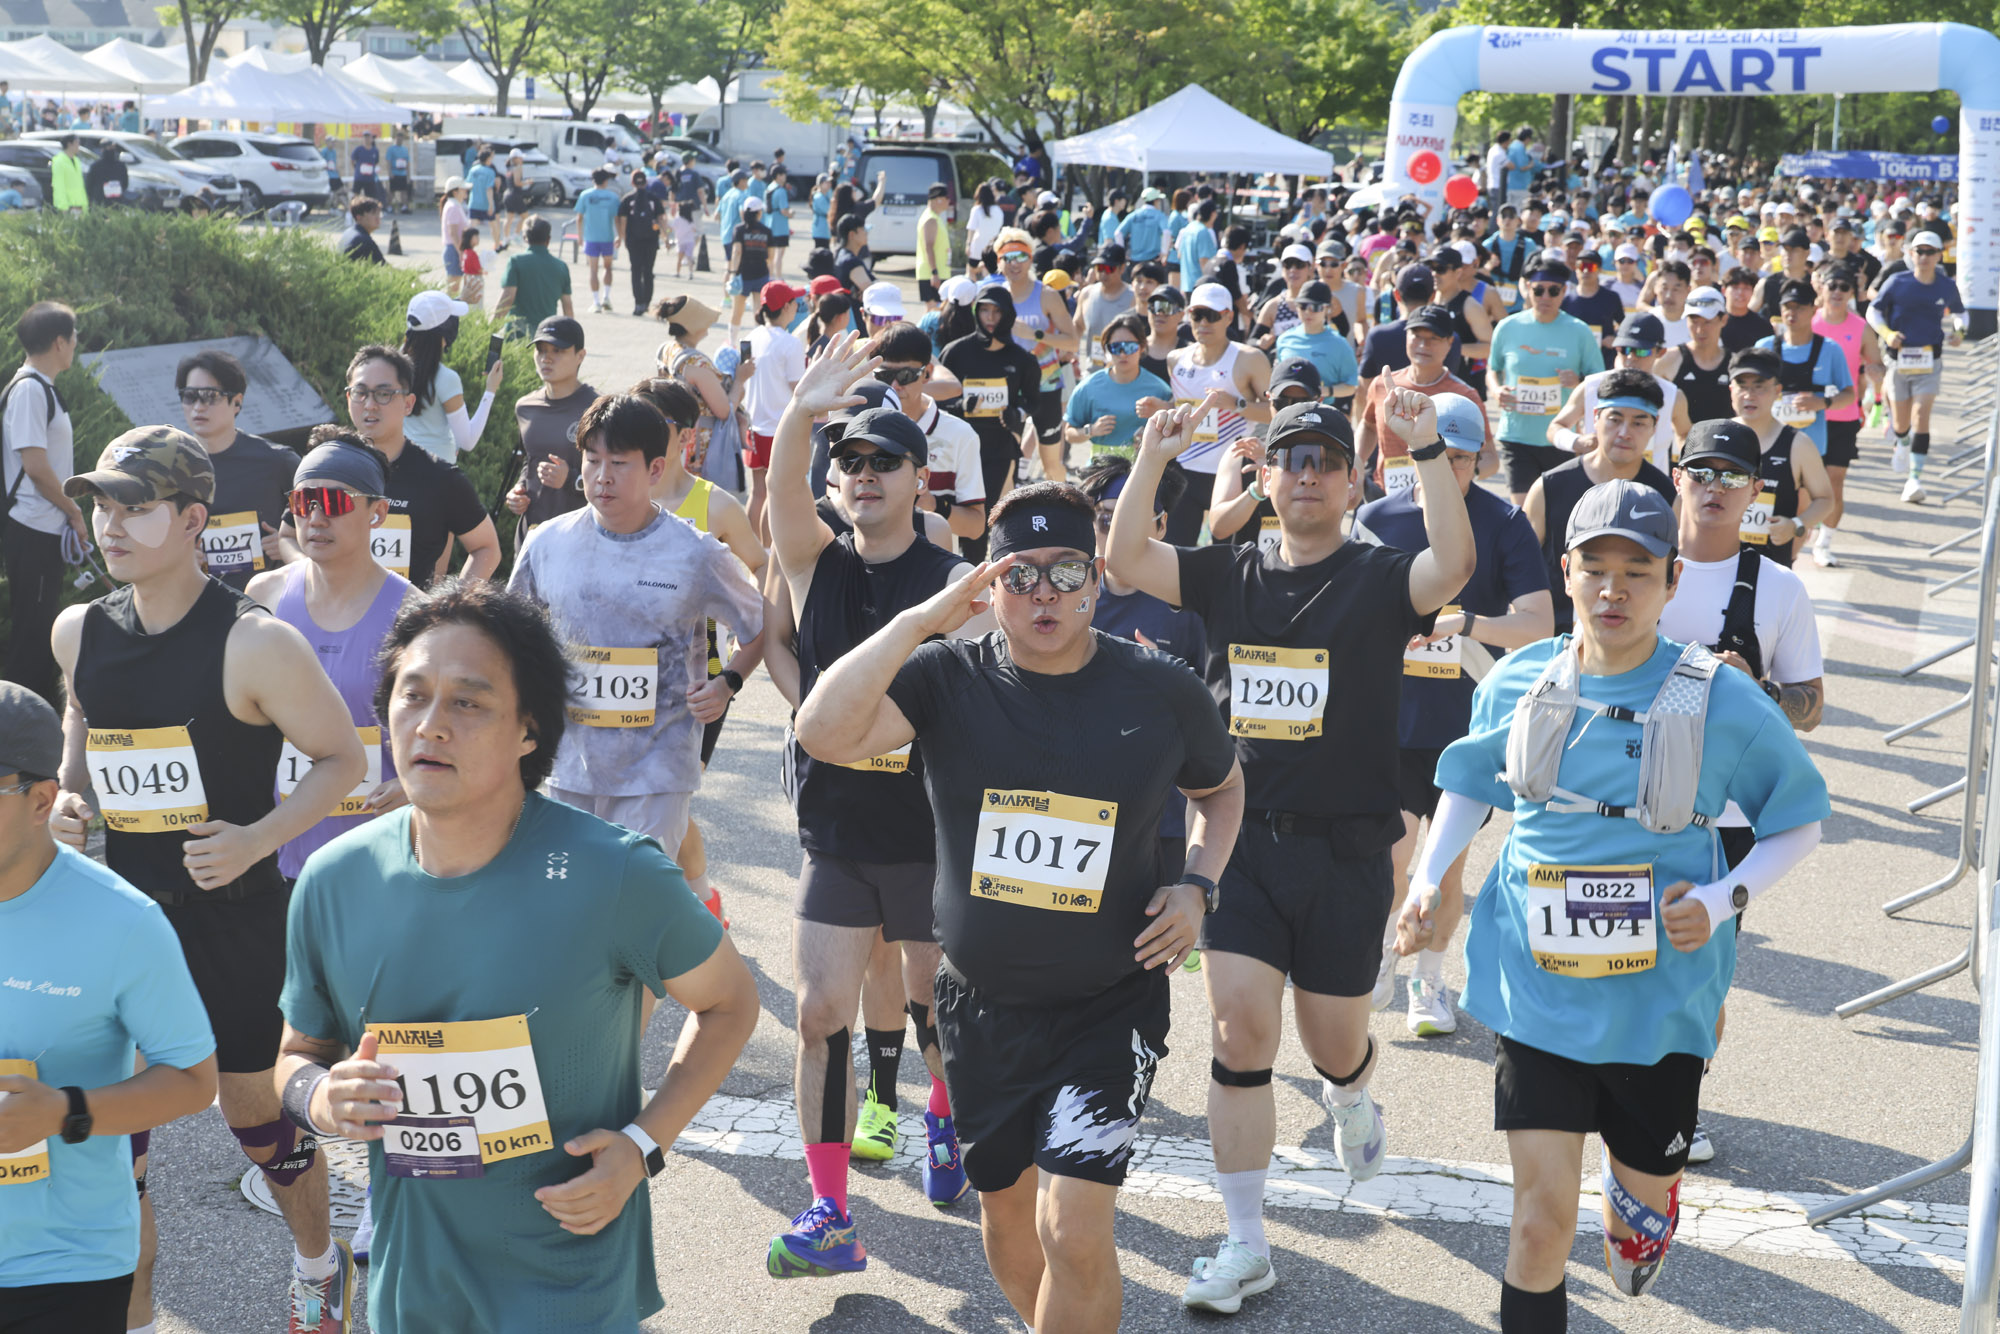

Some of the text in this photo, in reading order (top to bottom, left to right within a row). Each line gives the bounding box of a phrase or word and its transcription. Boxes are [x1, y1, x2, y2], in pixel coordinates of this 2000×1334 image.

[1591, 46, 1823, 93] START
[1878, 162, 1932, 177] 10km
[1520, 389, 1558, 402] 7045
[216, 552, 244, 564] 0275
[637, 579, 678, 591] SALOMON
[1427, 665, 1456, 675] 10 km
[572, 673, 649, 700] 2103
[1239, 677, 1319, 708] 1200
[620, 713, 650, 724] 10 km
[1288, 725, 1301, 736] 10
[89, 733, 135, 747] 시사저널
[870, 757, 905, 769] 10 km
[98, 761, 190, 797] 1049
[340, 802, 355, 811] 10
[162, 812, 203, 826] 10 km
[988, 826, 1102, 874] 1017
[1051, 891, 1068, 905] 10
[1582, 882, 1636, 899] 0822
[1607, 957, 1649, 971] 10 km
[2, 976, 33, 991] Just
[377, 1029, 445, 1048] 시사저널
[879, 1046, 898, 1057] TAS
[395, 1068, 527, 1116] 1196
[400, 1130, 462, 1152] 0206
[483, 1132, 541, 1156] 10 km
[10, 1163, 40, 1178] km
[1609, 1180, 1641, 1219] TAPE
[1642, 1214, 1664, 1235] BB
